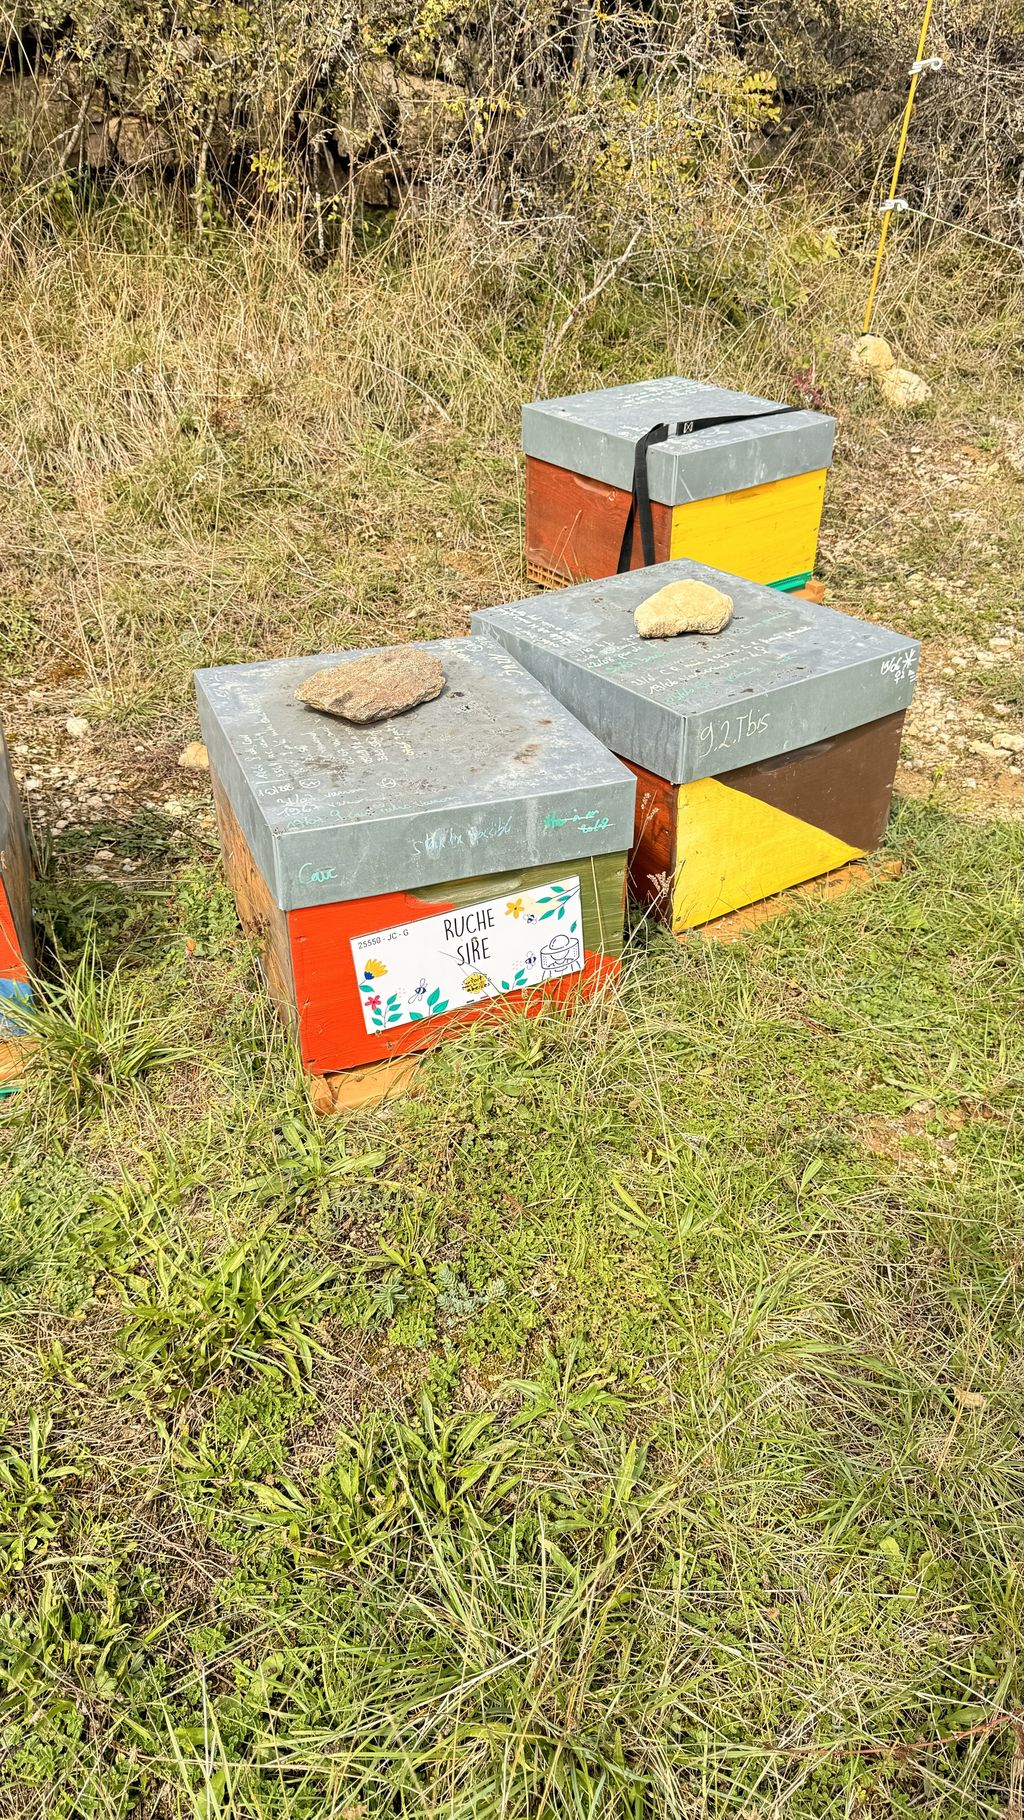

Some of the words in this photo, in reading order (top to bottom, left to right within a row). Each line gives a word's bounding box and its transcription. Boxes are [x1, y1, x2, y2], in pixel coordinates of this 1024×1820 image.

[357, 936, 381, 950] 25550
[387, 932, 397, 941] JC
[403, 928, 409, 937] G
[443, 908, 495, 941] RUCHE
[457, 937, 491, 967] SIRE
